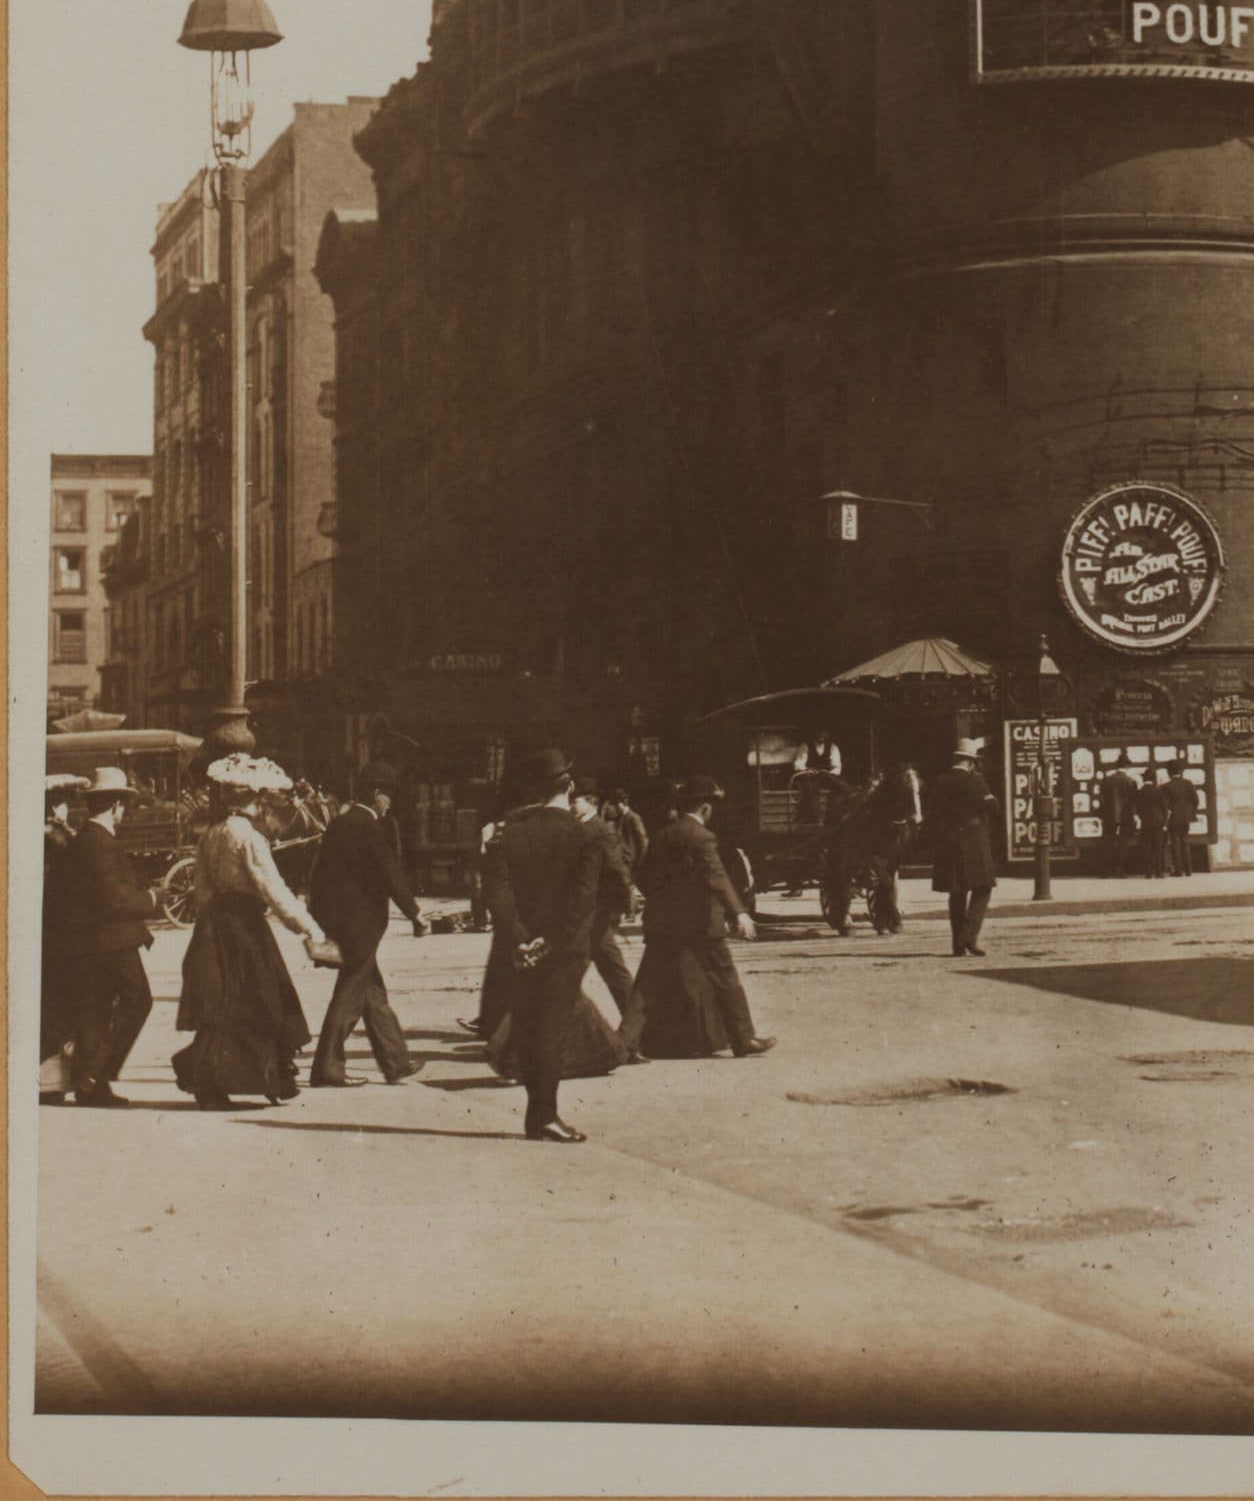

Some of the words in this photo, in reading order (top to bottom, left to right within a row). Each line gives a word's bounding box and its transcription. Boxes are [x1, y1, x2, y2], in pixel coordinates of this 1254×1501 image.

[1074, 515, 1116, 572] PIFF!
[1112, 501, 1177, 532] PAFF!
[1169, 520, 1208, 575] POUF!
[1012, 724, 1070, 742] CASINO
